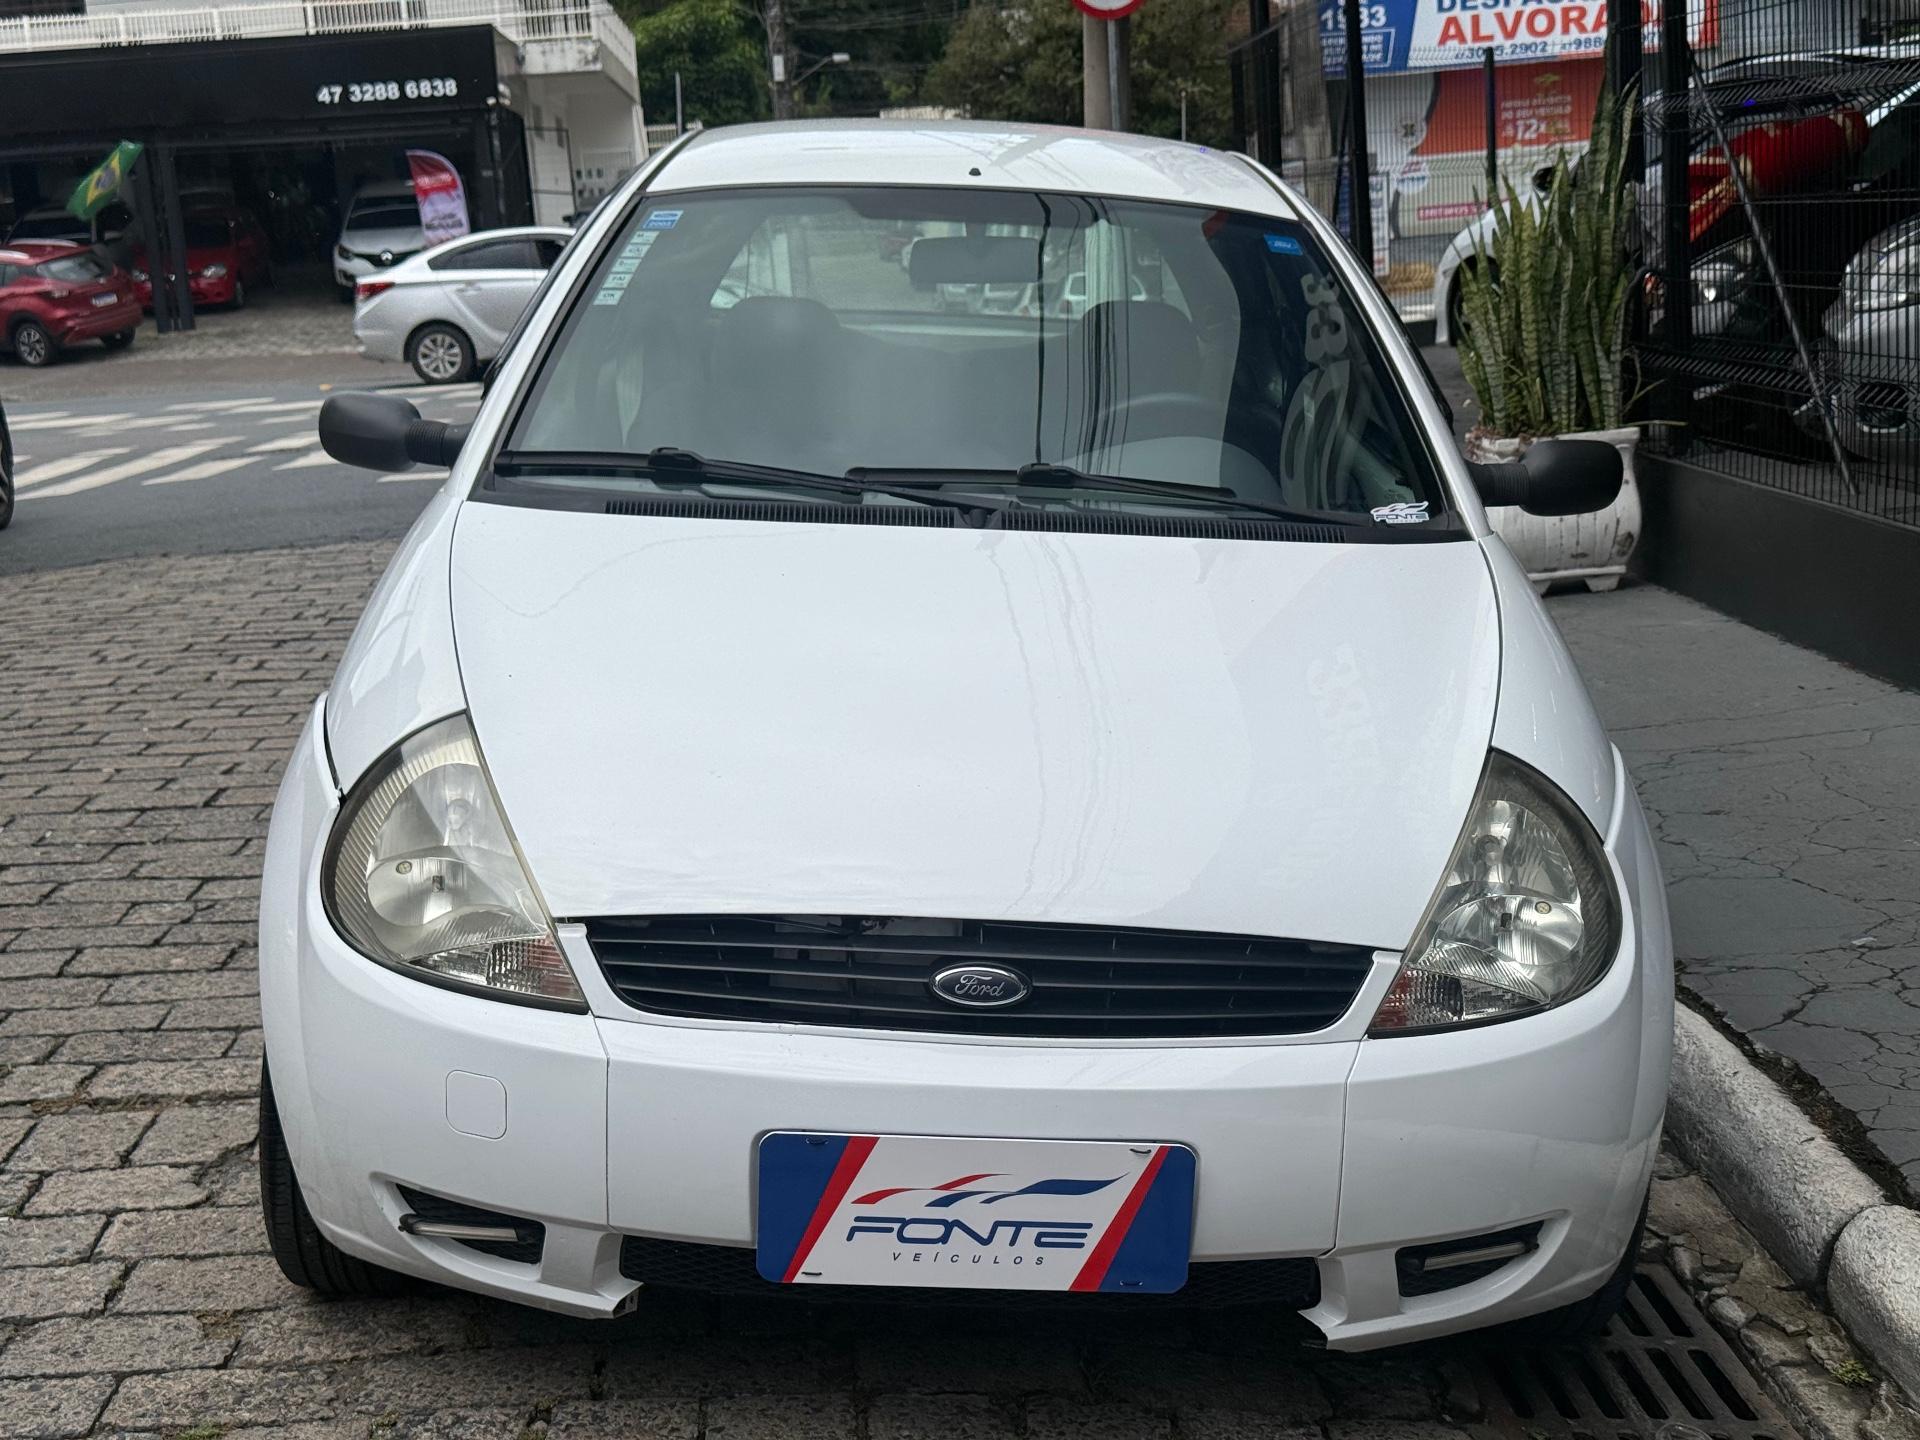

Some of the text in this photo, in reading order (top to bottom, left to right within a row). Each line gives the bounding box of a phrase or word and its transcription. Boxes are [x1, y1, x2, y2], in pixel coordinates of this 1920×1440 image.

[317, 78, 458, 103] 47 3288 6838
[954, 974, 1005, 996] Ford
[846, 1216, 1093, 1248] FONTE
[892, 1251, 1044, 1266] VEÍCULOS
